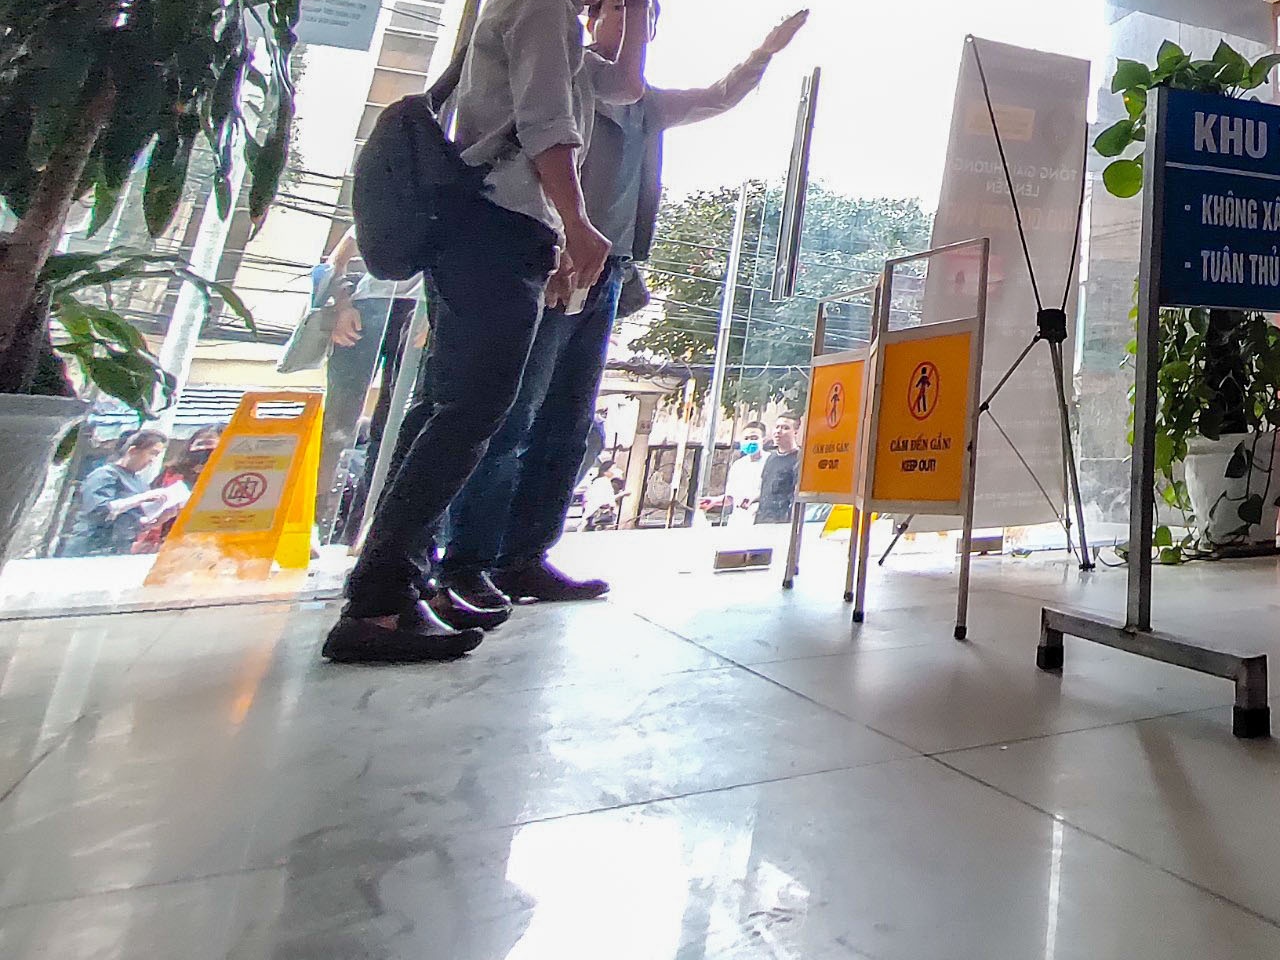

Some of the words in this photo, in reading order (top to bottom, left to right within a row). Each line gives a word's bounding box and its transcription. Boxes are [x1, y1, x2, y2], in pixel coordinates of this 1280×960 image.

[1194, 111, 1268, 159] KHU
[1202, 191, 1258, 229] KHÔNG
[1201, 245, 1244, 285] TUÂN
[1249, 245, 1280, 287] THỦ
[901, 459, 918, 472] KEEP
